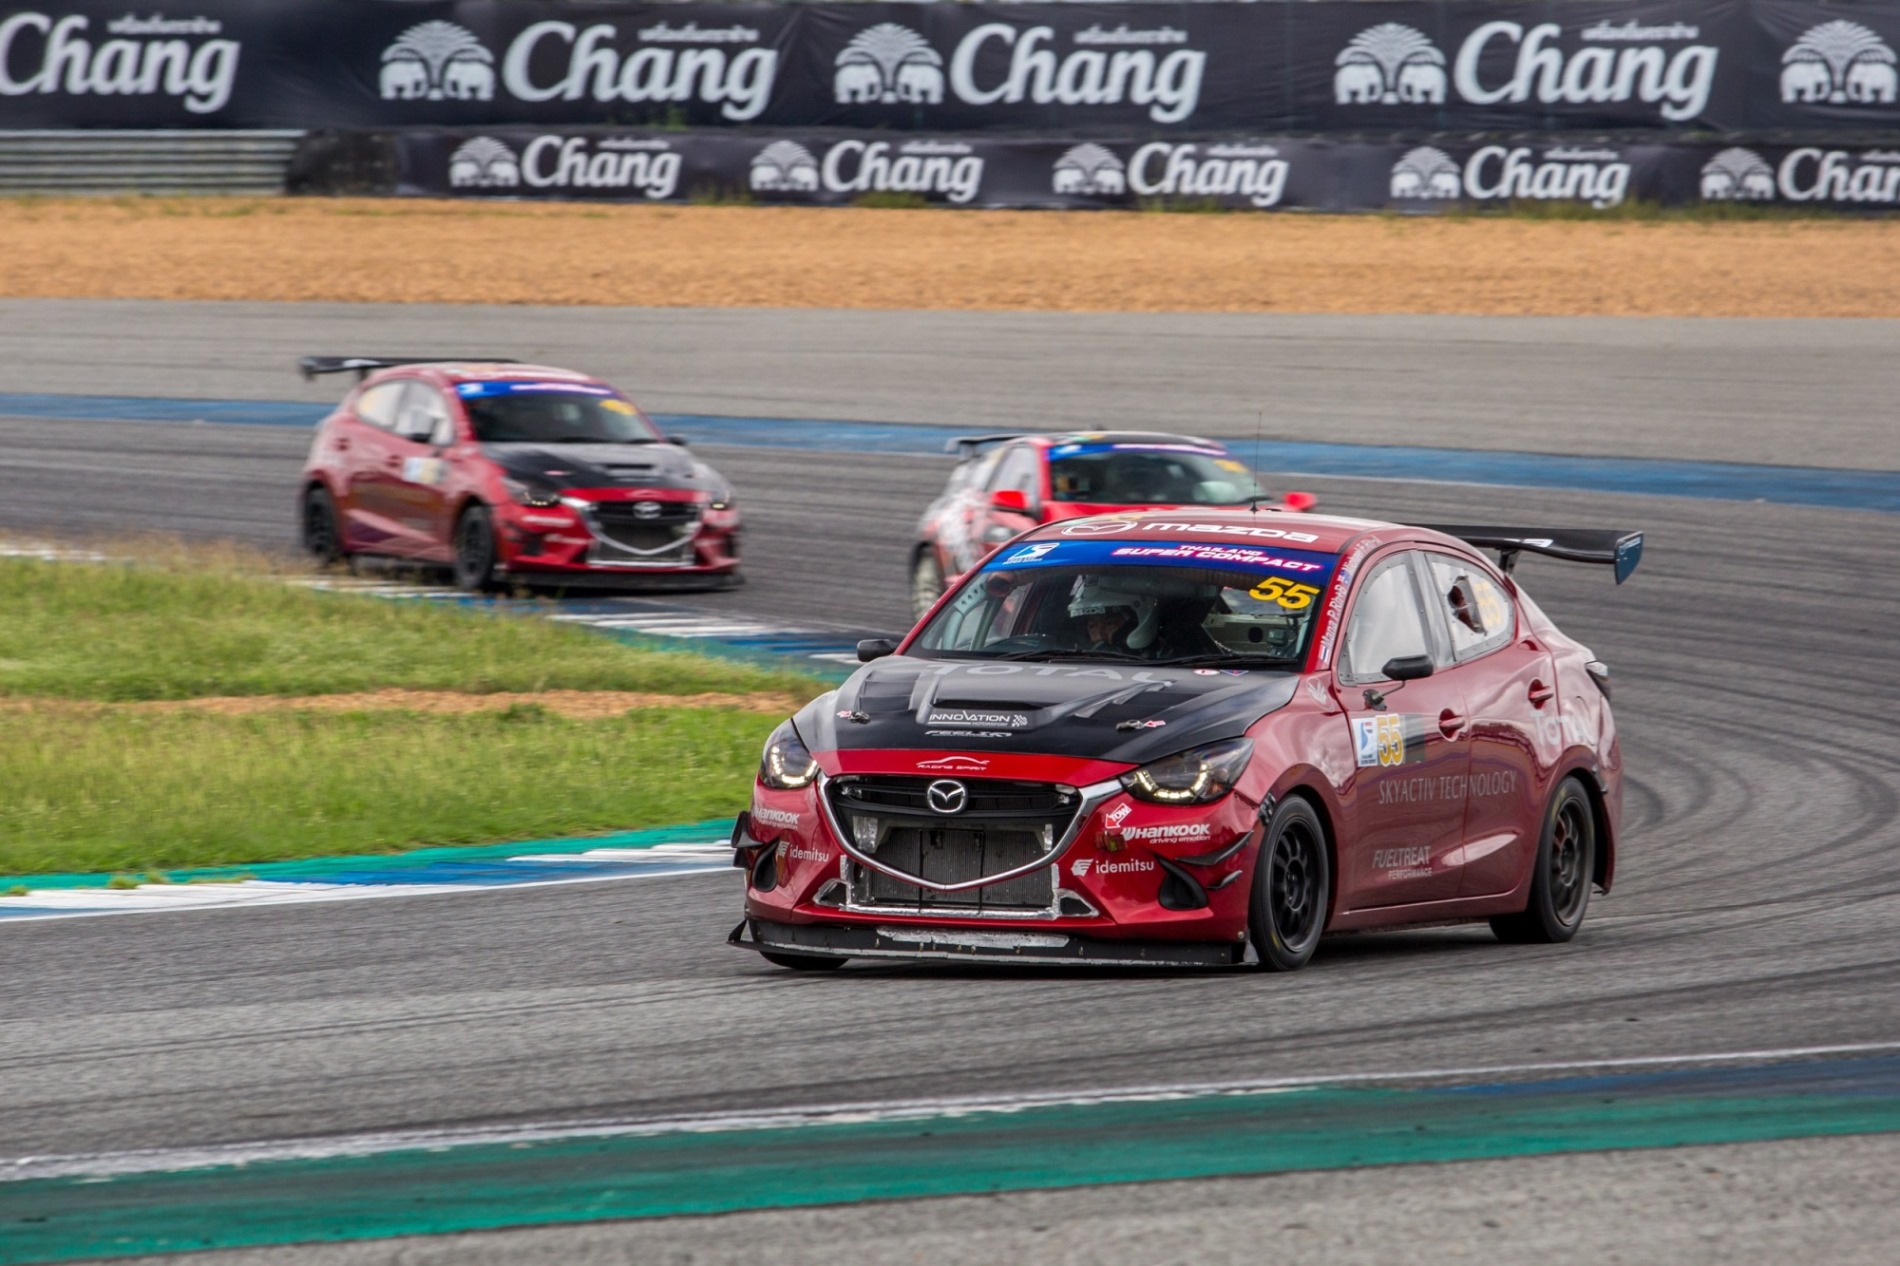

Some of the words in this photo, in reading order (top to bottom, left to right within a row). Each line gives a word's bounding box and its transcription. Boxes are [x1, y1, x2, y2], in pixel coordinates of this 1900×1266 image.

[0, 12, 239, 113] Chang
[504, 21, 778, 120] Chang
[950, 23, 1206, 123] Chang
[1454, 21, 1718, 120] Chang
[521, 135, 682, 199] Chang
[822, 139, 984, 203] Chang
[1128, 141, 1290, 206] Chang
[1463, 146, 1631, 208] Chang
[1113, 547, 1193, 557] SUPER
[1195, 550, 1322, 571] COMPACT
[1179, 545, 1264, 556] THAILAND
[1249, 576, 1320, 609] 55
[926, 662, 1174, 687] TOTAL
[929, 710, 1010, 722] INNOVATION
[1375, 713, 1404, 767] 55
[1378, 777, 1437, 804] SKYACTIV
[1439, 770, 1517, 800] TECHNOLOGY
[1111, 805, 1129, 821] TOW
[790, 844, 829, 862] idemitsu
[1096, 858, 1154, 874] idemitsu
[1372, 846, 1431, 869] FUELTREAT
[1388, 867, 1432, 880] PERFORMANCE
